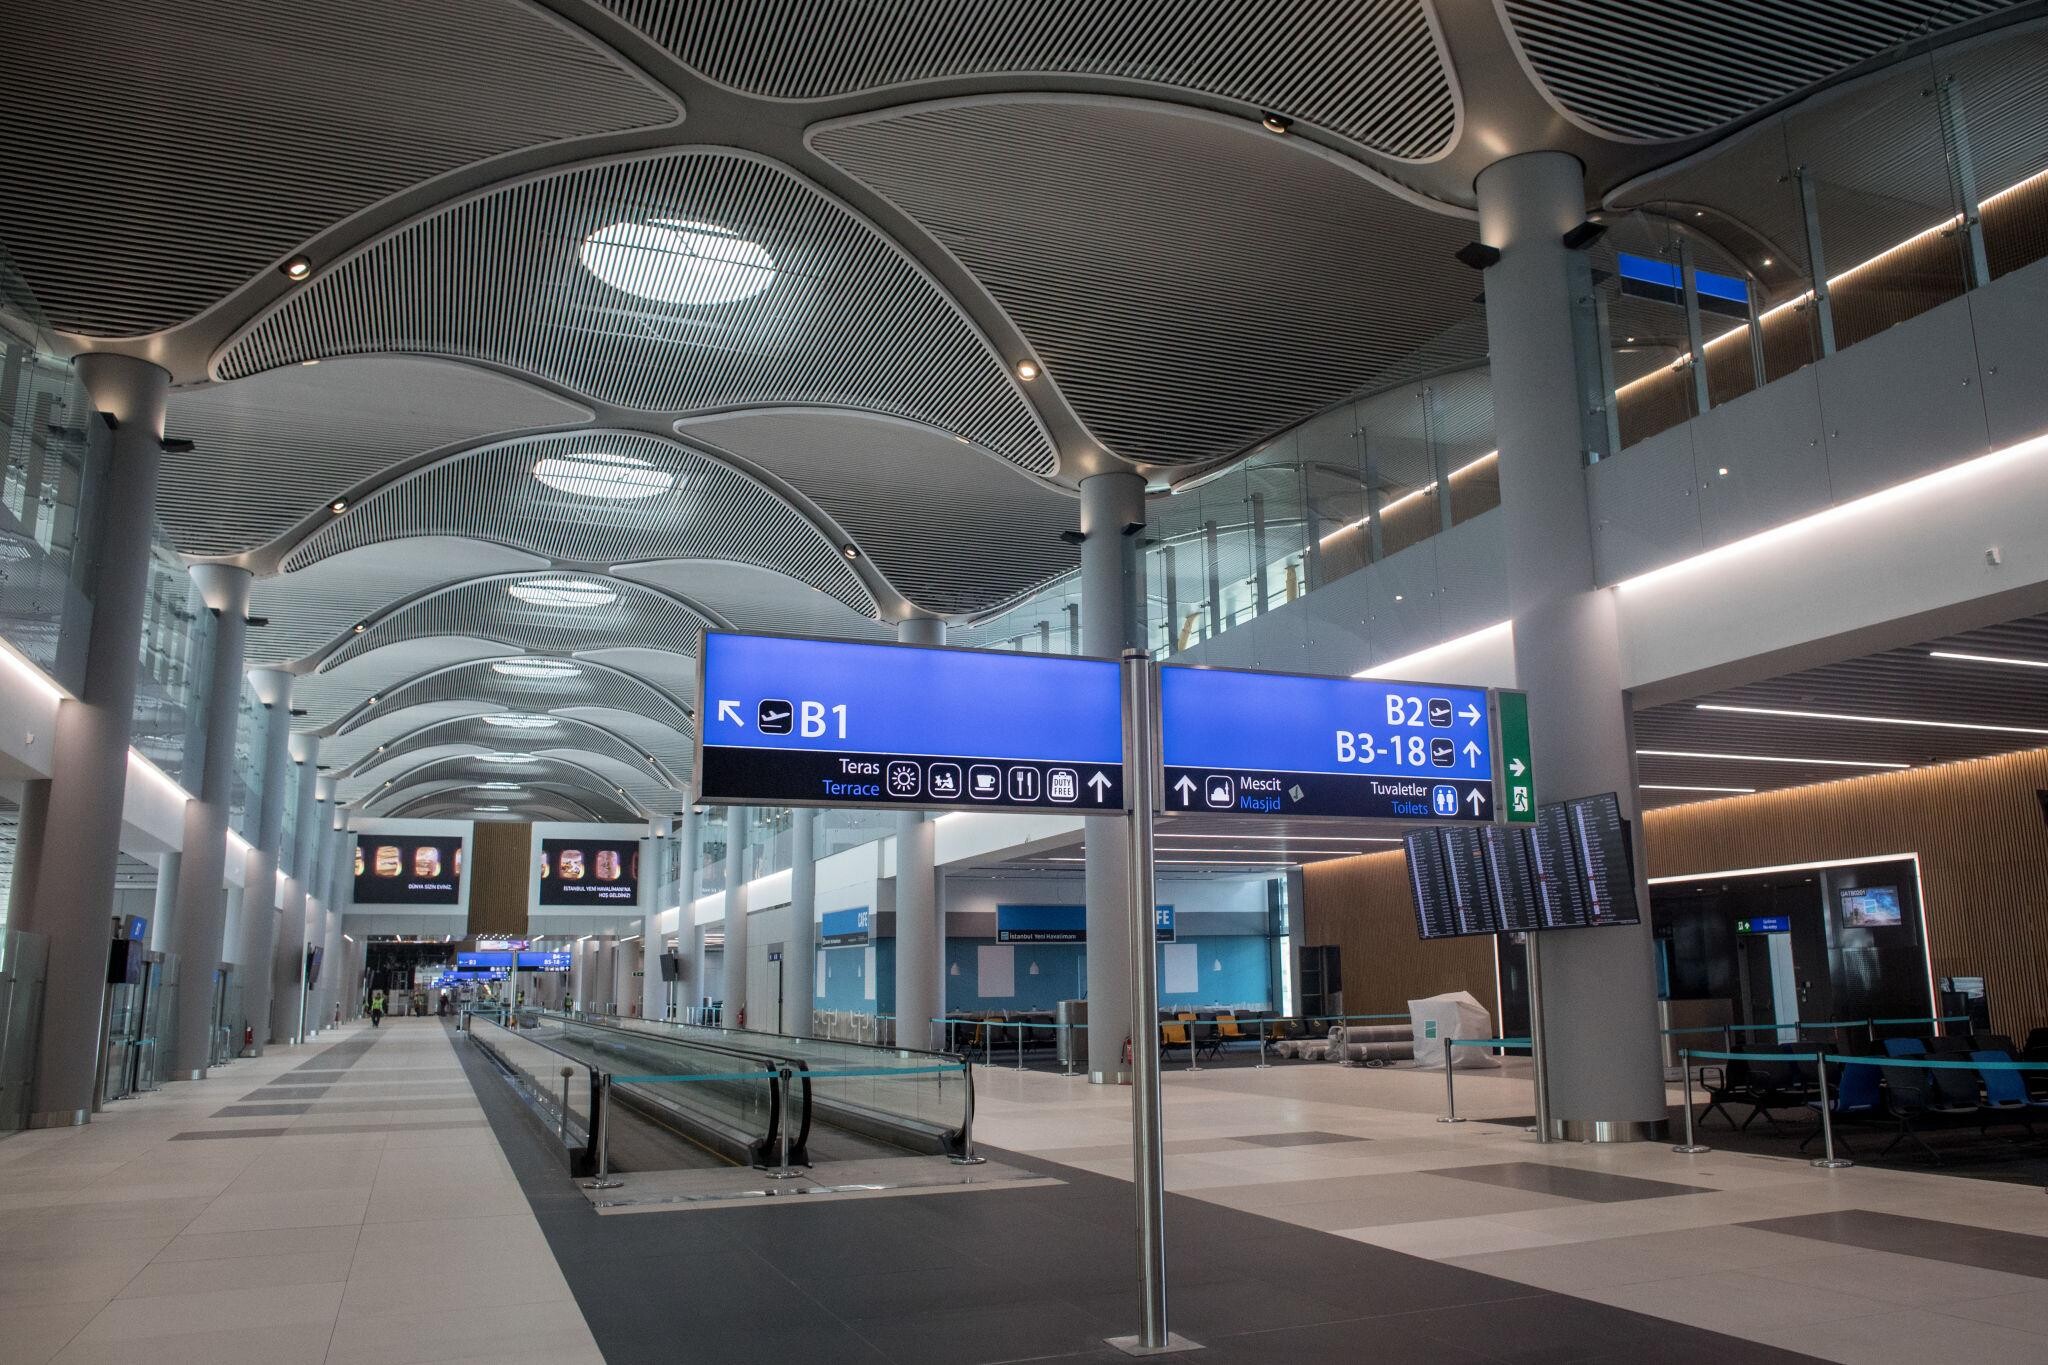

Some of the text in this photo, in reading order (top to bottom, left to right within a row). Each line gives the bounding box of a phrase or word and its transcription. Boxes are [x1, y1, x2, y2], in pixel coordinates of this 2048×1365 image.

[1386, 694, 1424, 727] B2
[800, 700, 848, 739] B1
[1336, 730, 1426, 767] B3-18
[839, 758, 880, 776] Teras
[822, 779, 880, 797] Terrace
[1054, 778, 1071, 787] DUTY
[1240, 776, 1281, 792] Mescit
[1370, 781, 1427, 797] Tuvaletler
[1054, 787, 1071, 796] FREE
[1240, 795, 1281, 814] Masjid
[1392, 801, 1428, 815] Toilets
[858, 911, 868, 928] CAFE
[1156, 910, 1170, 925] FE
